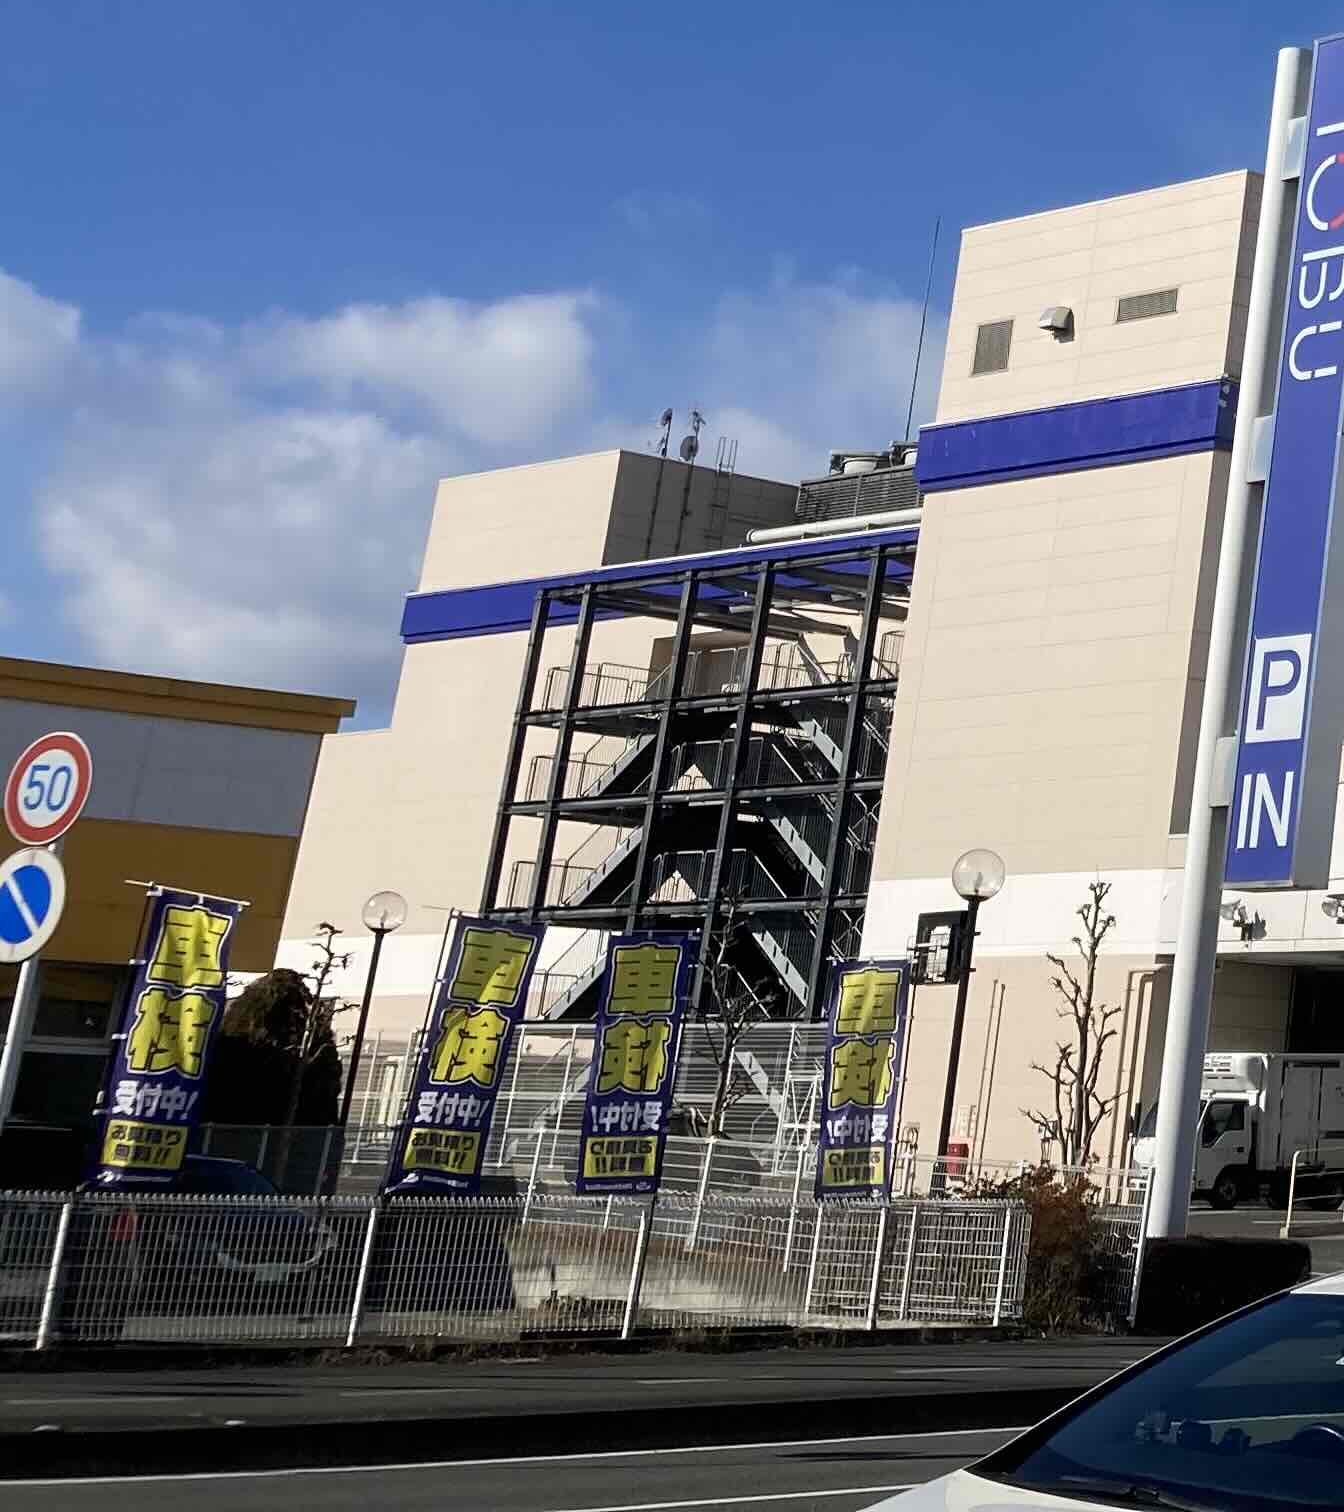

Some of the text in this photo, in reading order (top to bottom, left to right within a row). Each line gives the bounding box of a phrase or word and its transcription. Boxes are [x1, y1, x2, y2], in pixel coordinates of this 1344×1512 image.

[1256, 650, 1301, 731] P
[24, 765, 72, 811] 50
[1237, 771, 1294, 849] IN
[126, 904, 232, 1079] 車検
[428, 927, 537, 1088] 車検
